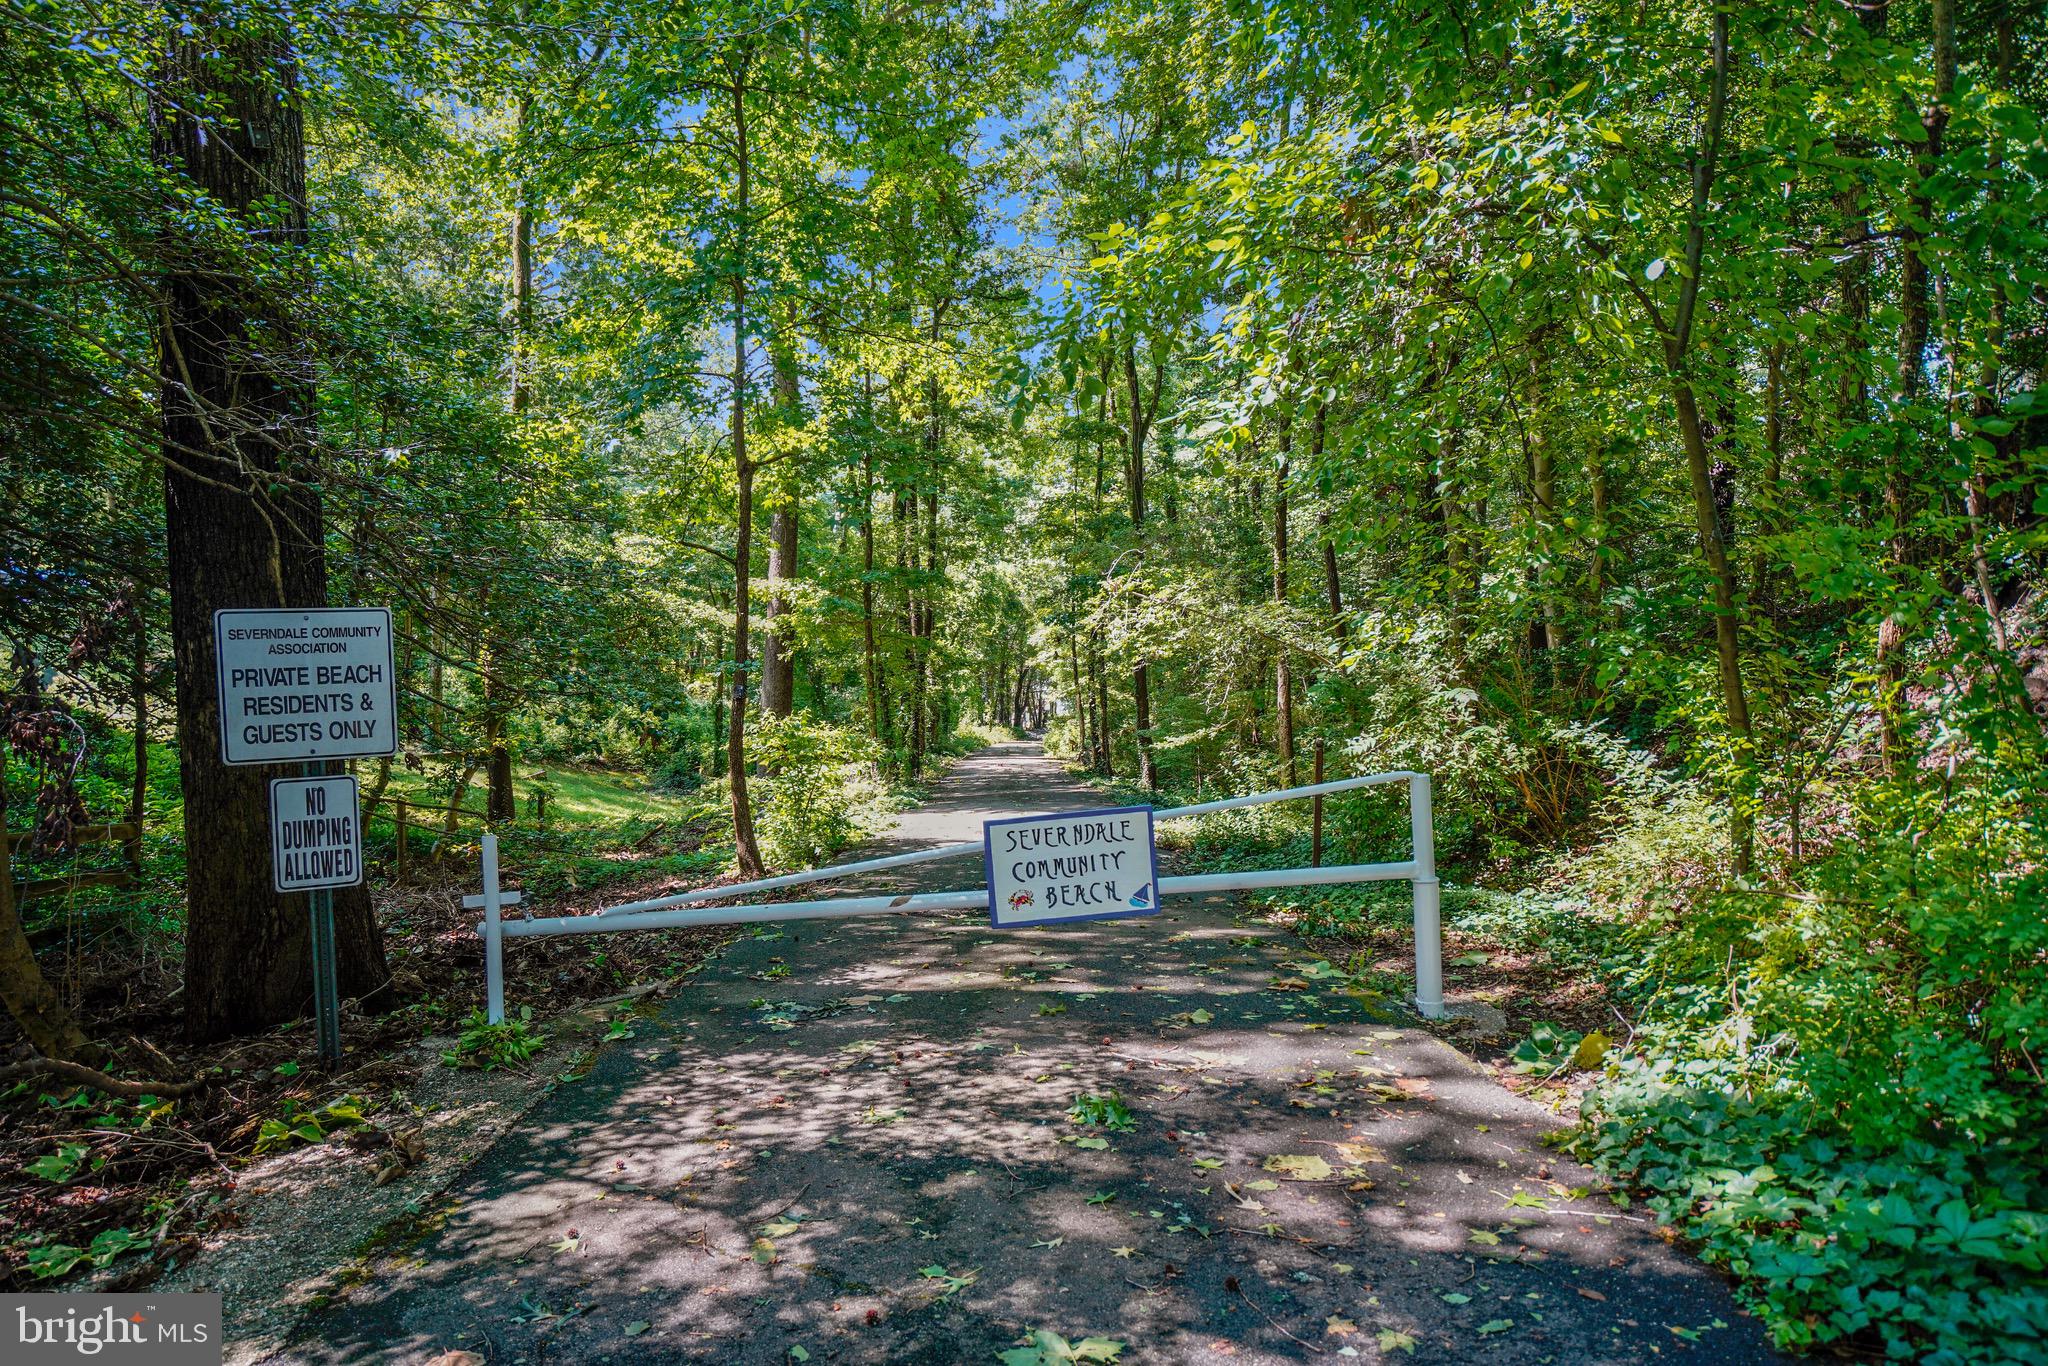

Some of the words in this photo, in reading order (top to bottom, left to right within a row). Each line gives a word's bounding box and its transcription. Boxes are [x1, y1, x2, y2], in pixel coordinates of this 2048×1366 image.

[228, 628, 308, 640] SEVERNDALE
[312, 626, 381, 638] COMMUNITY
[268, 642, 347, 655] ASSOCIATION
[231, 666, 310, 688] PRIVATE
[316, 664, 382, 685] BEACH
[243, 692, 353, 716] RESIDENTS
[360, 692, 373, 711] &
[243, 722, 322, 745] GUESTS
[329, 719, 376, 740] ONLY
[305, 786, 326, 816] NO
[282, 816, 352, 850] DUMPING
[1006, 820, 1134, 853] SEVERNDALE
[284, 848, 353, 882] ALLOWED
[1011, 850, 1126, 883] COMMUNITY
[1045, 880, 1122, 909] BEACH
